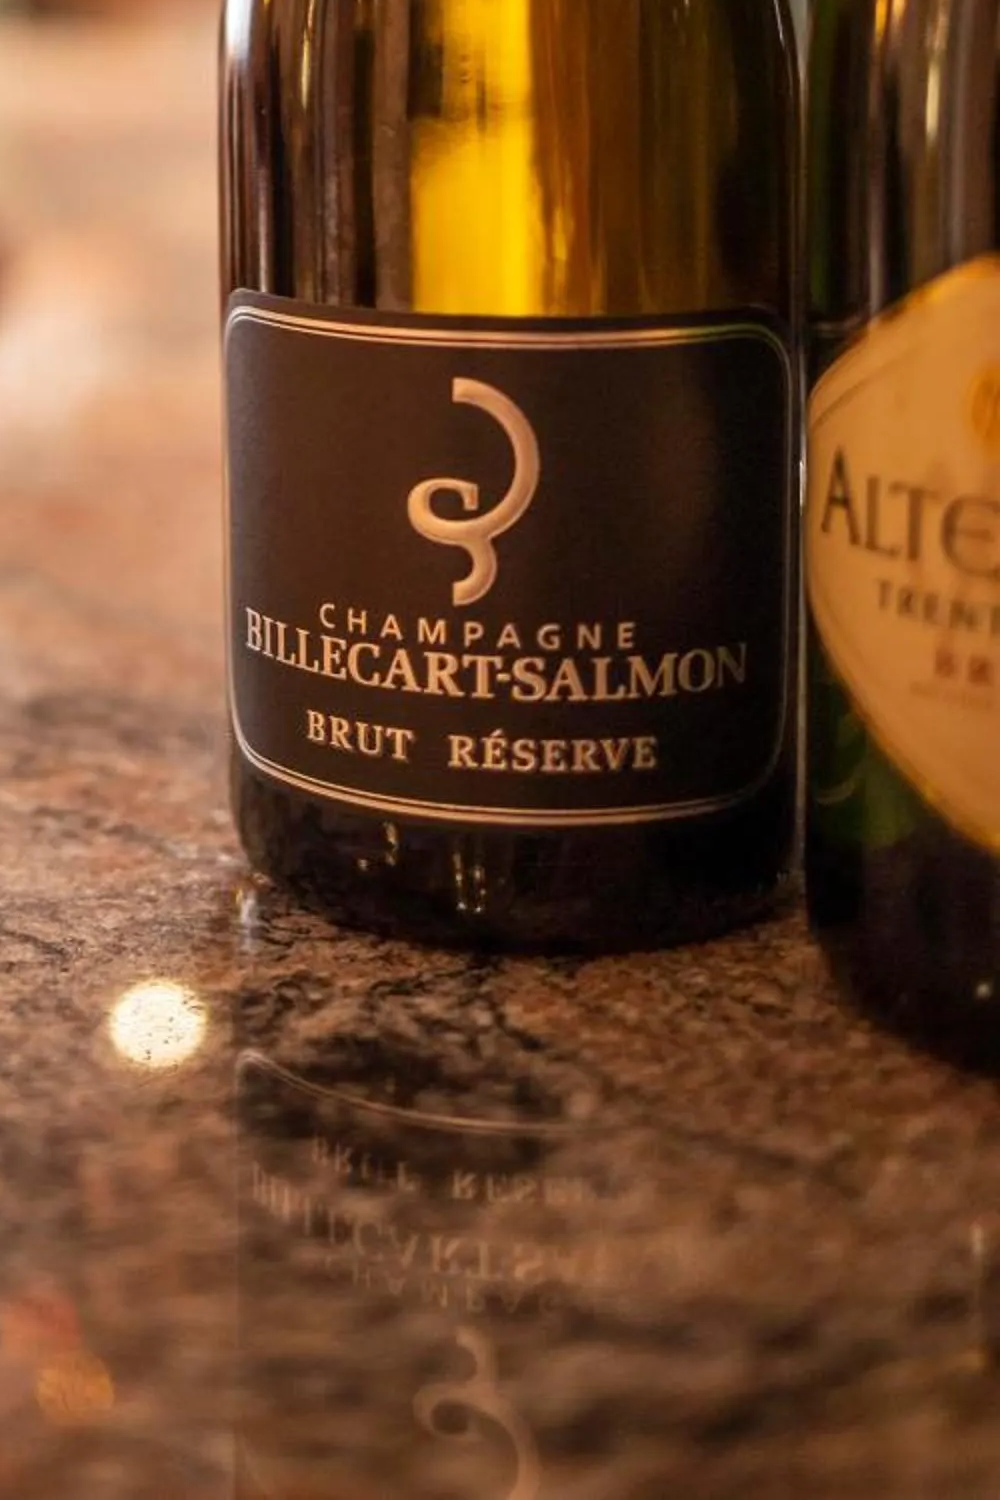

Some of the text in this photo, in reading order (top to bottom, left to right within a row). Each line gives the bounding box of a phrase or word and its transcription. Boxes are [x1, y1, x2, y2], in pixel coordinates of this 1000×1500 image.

[245, 606, 748, 702] BILLECART-SALMON
[318, 602, 637, 650] CHAMPAGNE
[306, 708, 658, 773] BRUT RÉSERVE
